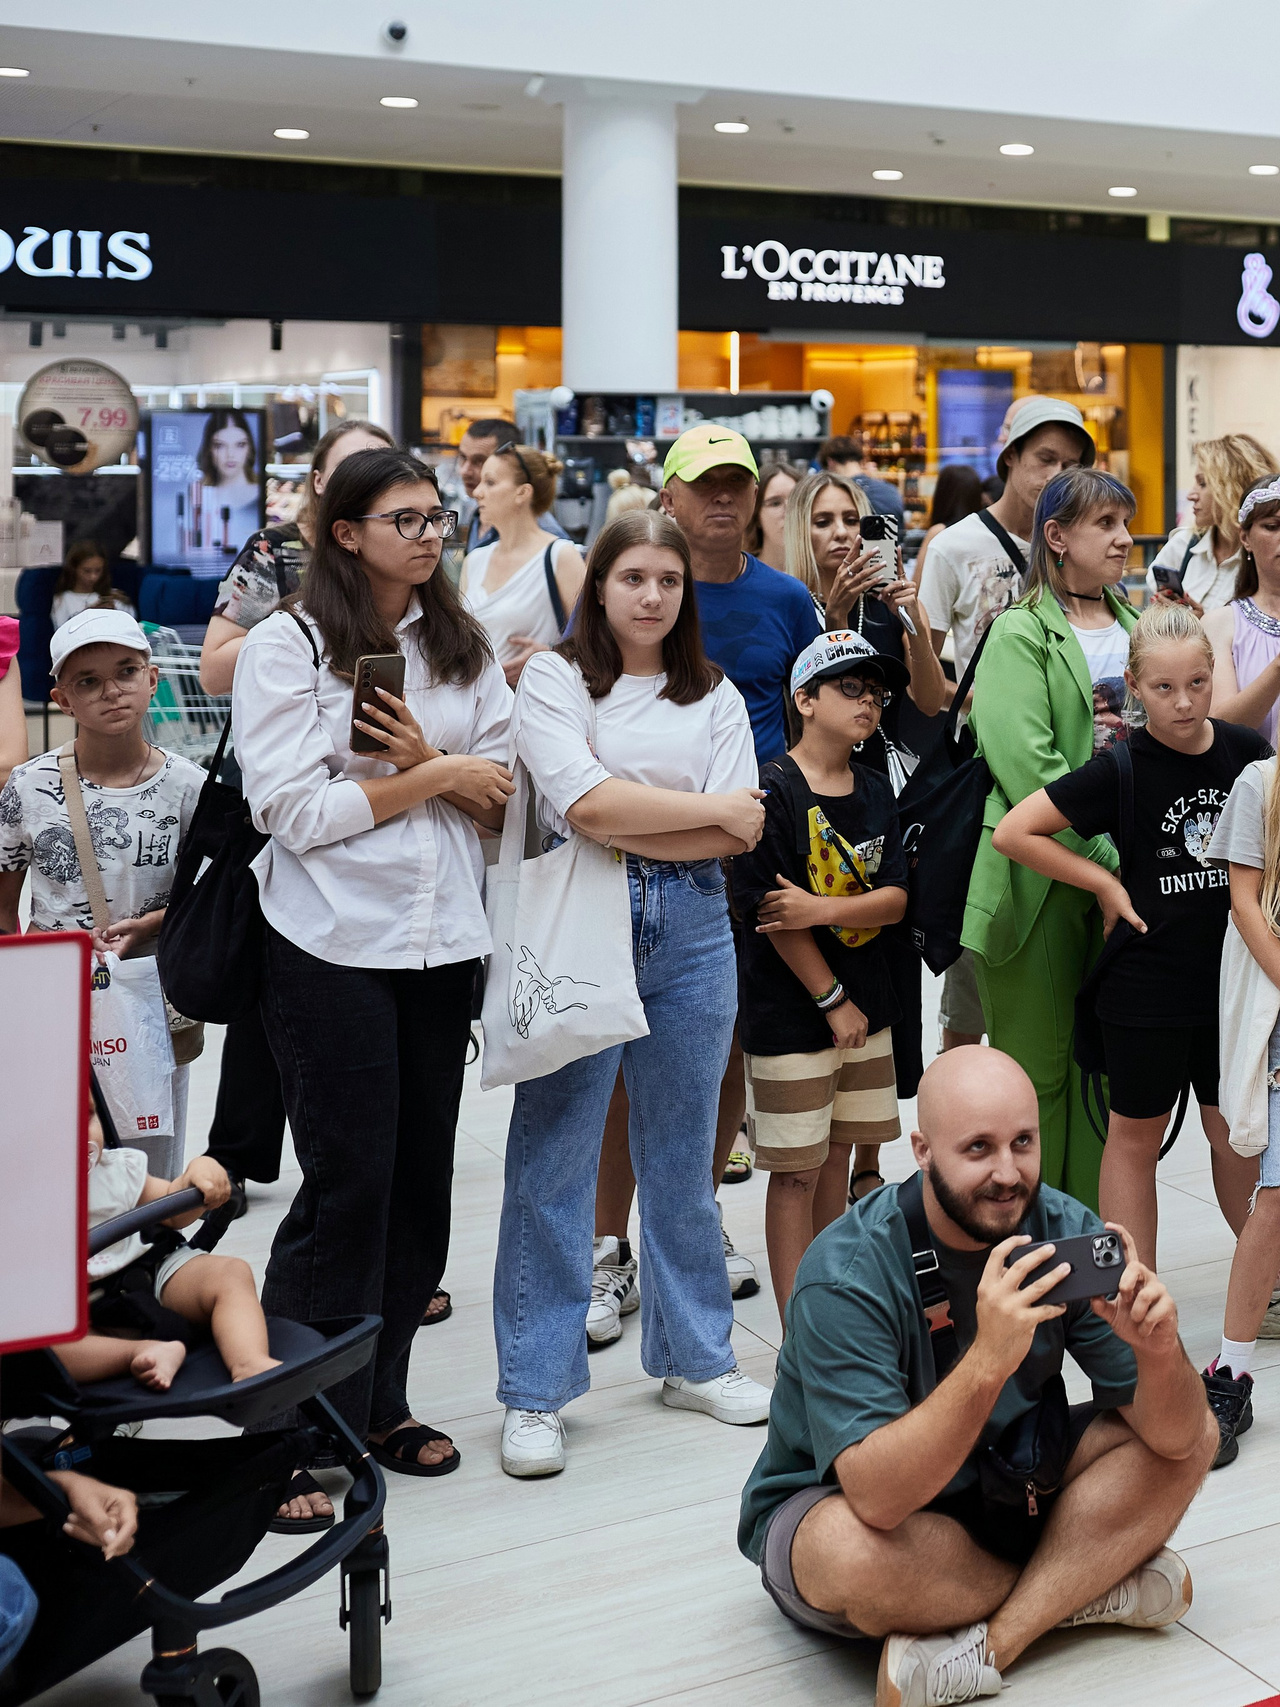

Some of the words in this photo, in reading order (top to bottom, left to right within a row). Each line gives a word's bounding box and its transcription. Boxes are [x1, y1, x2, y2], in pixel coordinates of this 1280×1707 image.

[0, 226, 153, 281] UIS
[720, 239, 946, 289] L'OCCITANE
[767, 281, 798, 301] EN
[800, 282, 905, 305] PROVENCE
